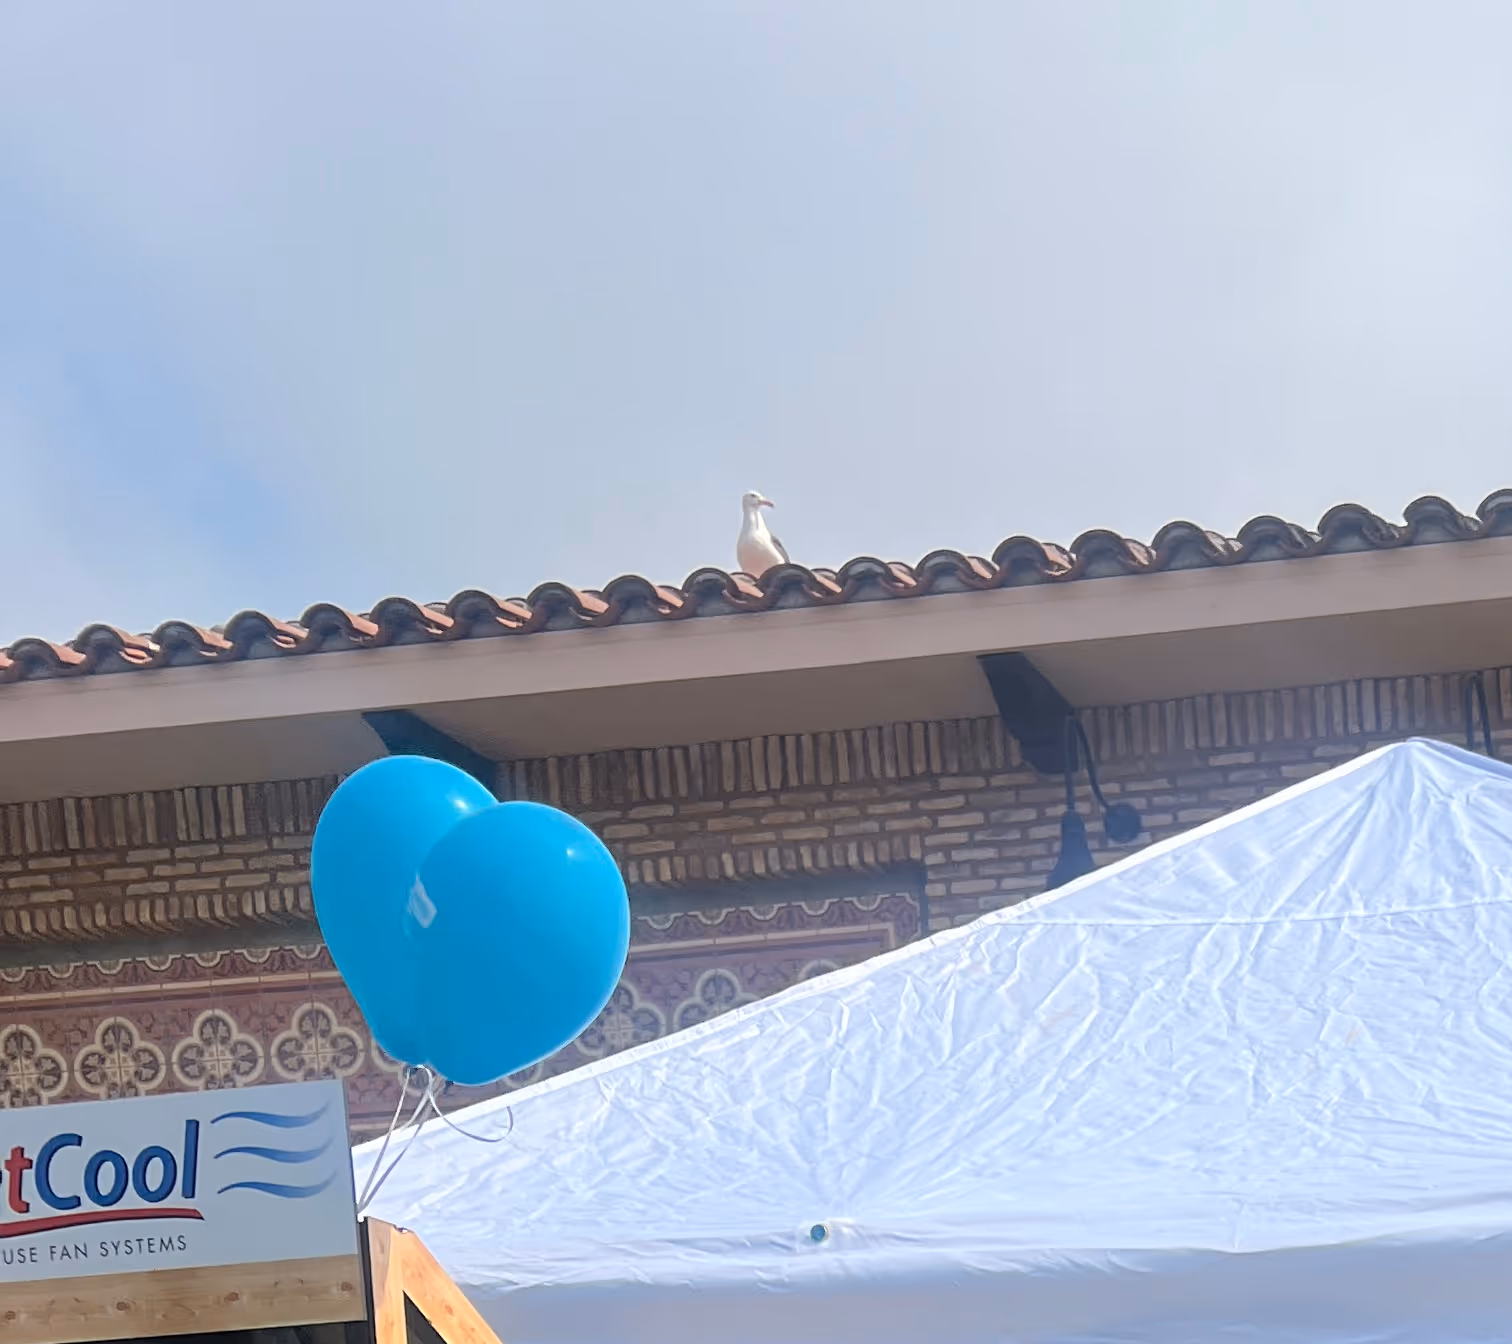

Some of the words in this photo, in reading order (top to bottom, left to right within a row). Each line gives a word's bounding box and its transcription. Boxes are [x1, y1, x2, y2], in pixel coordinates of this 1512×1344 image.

[0, 1119, 199, 1214] tCool
[50, 1243, 88, 1261] FAN
[100, 1235, 187, 1257] SYSTEMS
